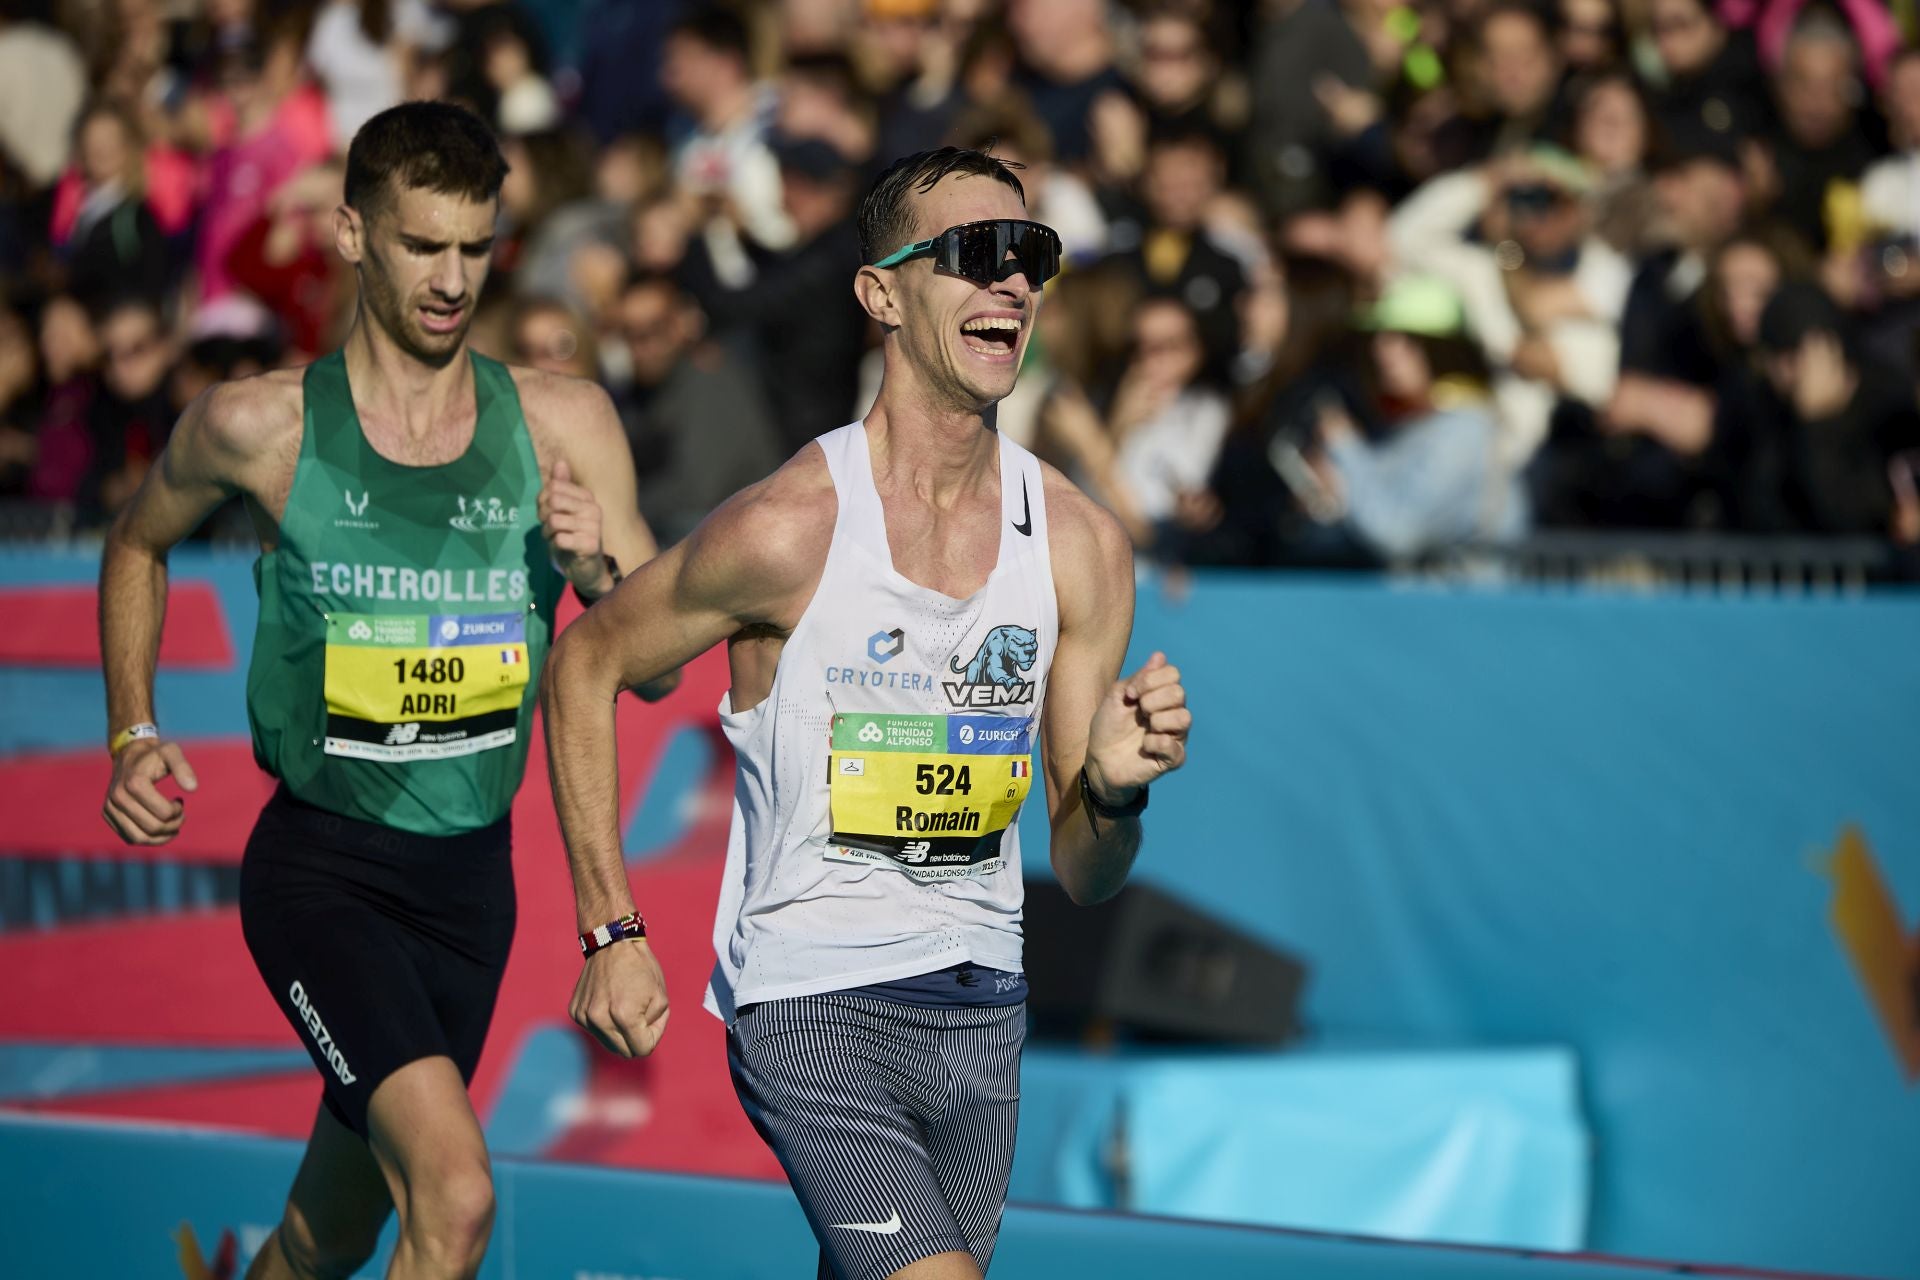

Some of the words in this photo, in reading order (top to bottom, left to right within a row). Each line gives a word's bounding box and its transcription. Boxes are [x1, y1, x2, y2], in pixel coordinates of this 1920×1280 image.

[310, 562, 526, 602] ECHIROLLES
[462, 621, 505, 636] ZURICH
[393, 657, 464, 684] 1480
[826, 666, 933, 692] CRYOTERA
[400, 693, 456, 715] ADRI
[942, 681, 1036, 707] VEMA
[886, 727, 934, 737] TRINIDAD
[886, 737, 933, 746] ALFONSO
[978, 730, 1019, 741] ZURICH
[916, 764, 971, 796] 524
[1006, 788, 1015, 798] 01
[896, 805, 981, 831] Romain
[929, 855, 943, 863] new
[943, 853, 971, 862] balance
[936, 869, 966, 878] ALFONSO
[290, 980, 357, 1085] ADIZERO
